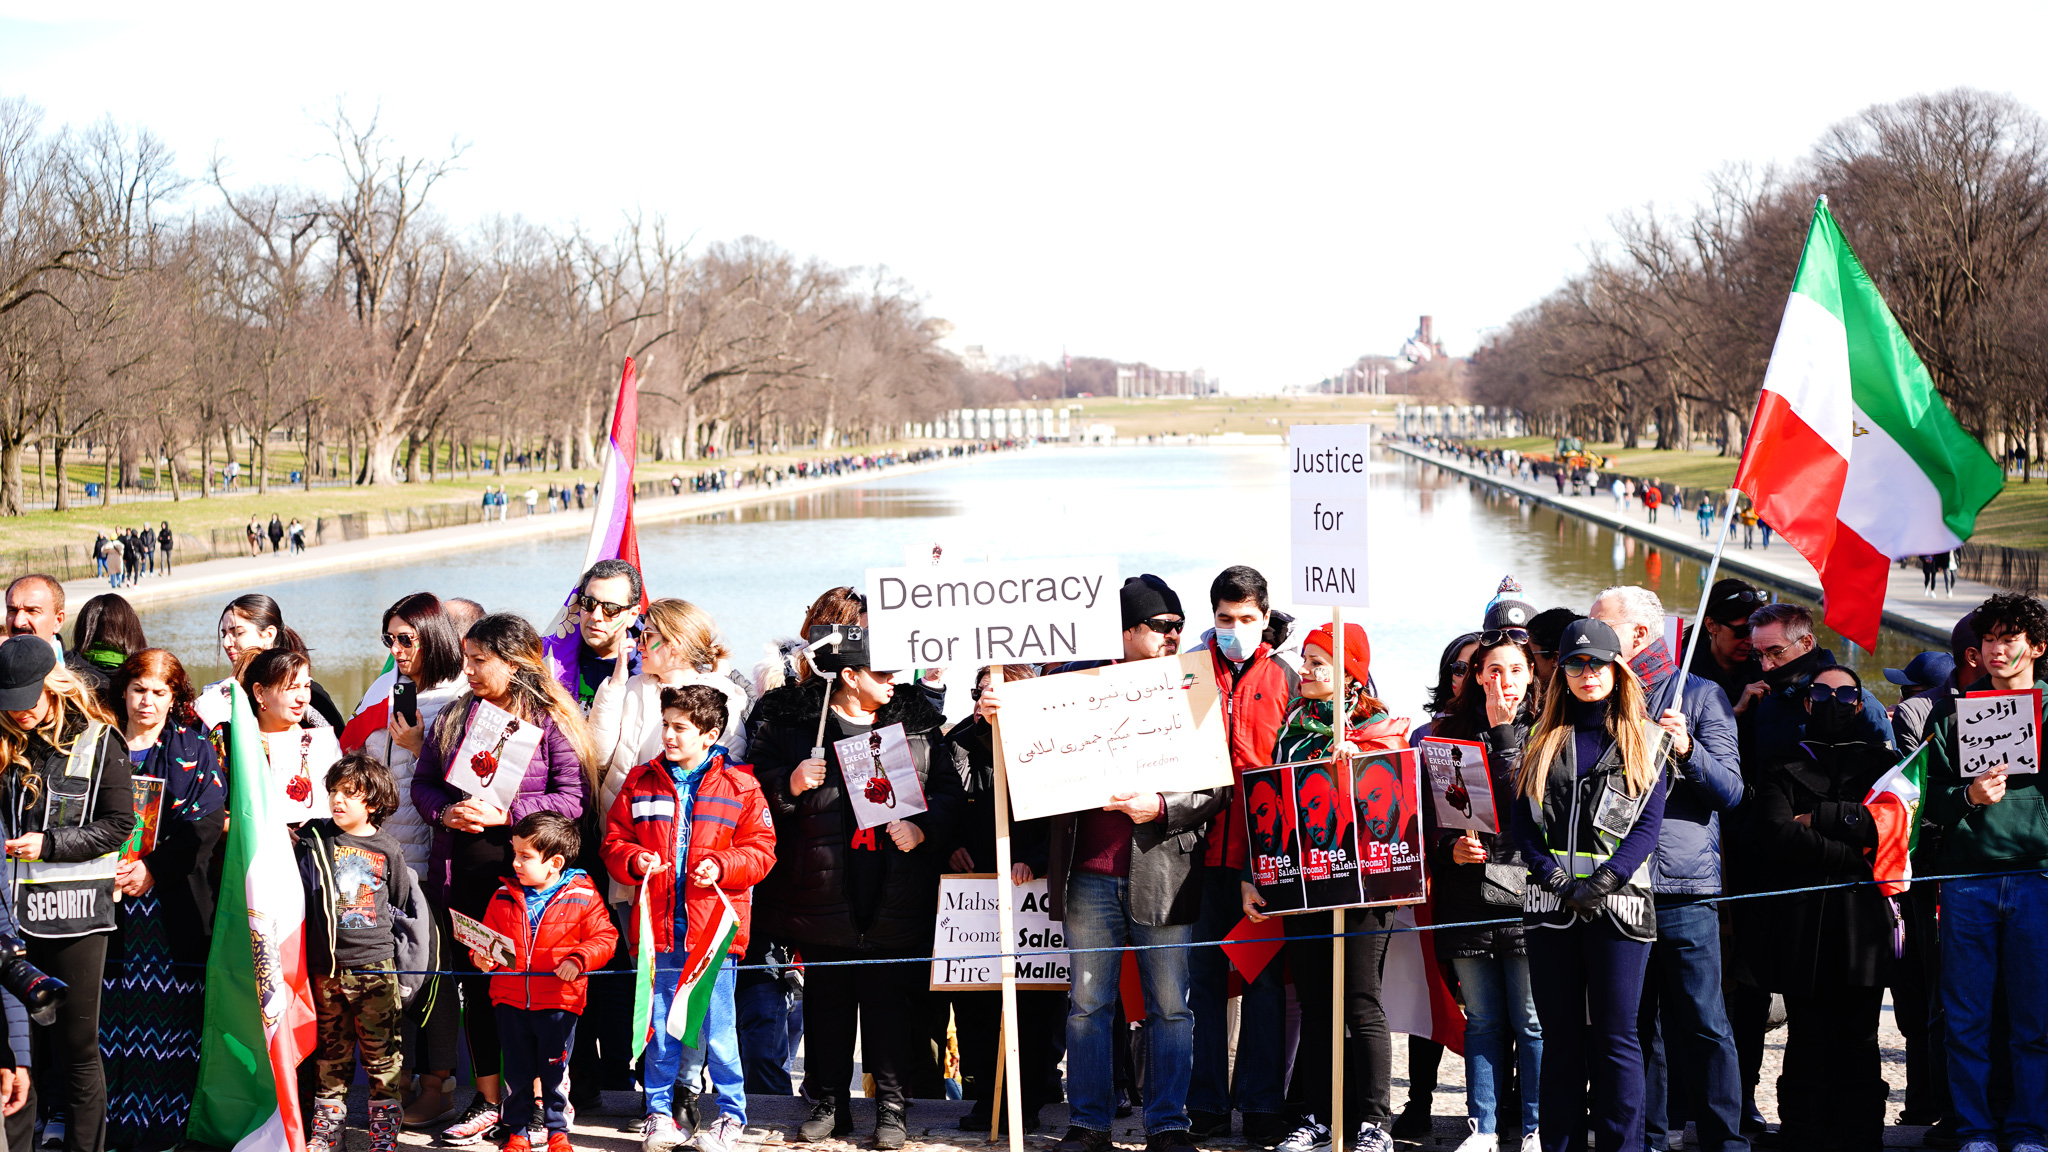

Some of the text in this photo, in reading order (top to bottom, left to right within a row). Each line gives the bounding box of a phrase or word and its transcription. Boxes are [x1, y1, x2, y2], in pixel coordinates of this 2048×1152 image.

[1293, 446, 1364, 473] Justice
[1313, 502, 1344, 531] for
[1305, 565, 1355, 594] IRAN
[879, 574, 1103, 611] Democracy
[907, 622, 1078, 663] for IRAN
[1965, 698, 2017, 725] آزادی
[473, 725, 483, 734] IN
[1960, 723, 2034, 750] از سوریه
[841, 740, 869, 755] STOP
[1018, 737, 1056, 764] اسلامی
[1060, 733, 1102, 754] جمهوری
[1426, 746, 1452, 758] STOP
[844, 747, 887, 764] EXECUTION
[1428, 757, 1467, 768] EXECUTION
[1963, 751, 2036, 774] به ایران
[846, 763, 856, 772] IN
[1136, 754, 1179, 776] Freedom
[1430, 764, 1439, 772] IN
[1310, 848, 1347, 865] Free
[1369, 841, 1410, 858] Free
[1259, 854, 1291, 870] Free
[1302, 860, 1358, 875] Toomaj Salehi
[1360, 853, 1421, 868] Toomaj Salehi
[1278, 866, 1301, 877] Salehi
[1332, 871, 1350, 879] rapper
[1370, 864, 1412, 875] Iranian rapper
[27, 888, 97, 922] SECURITY
[944, 959, 990, 983] Fire
